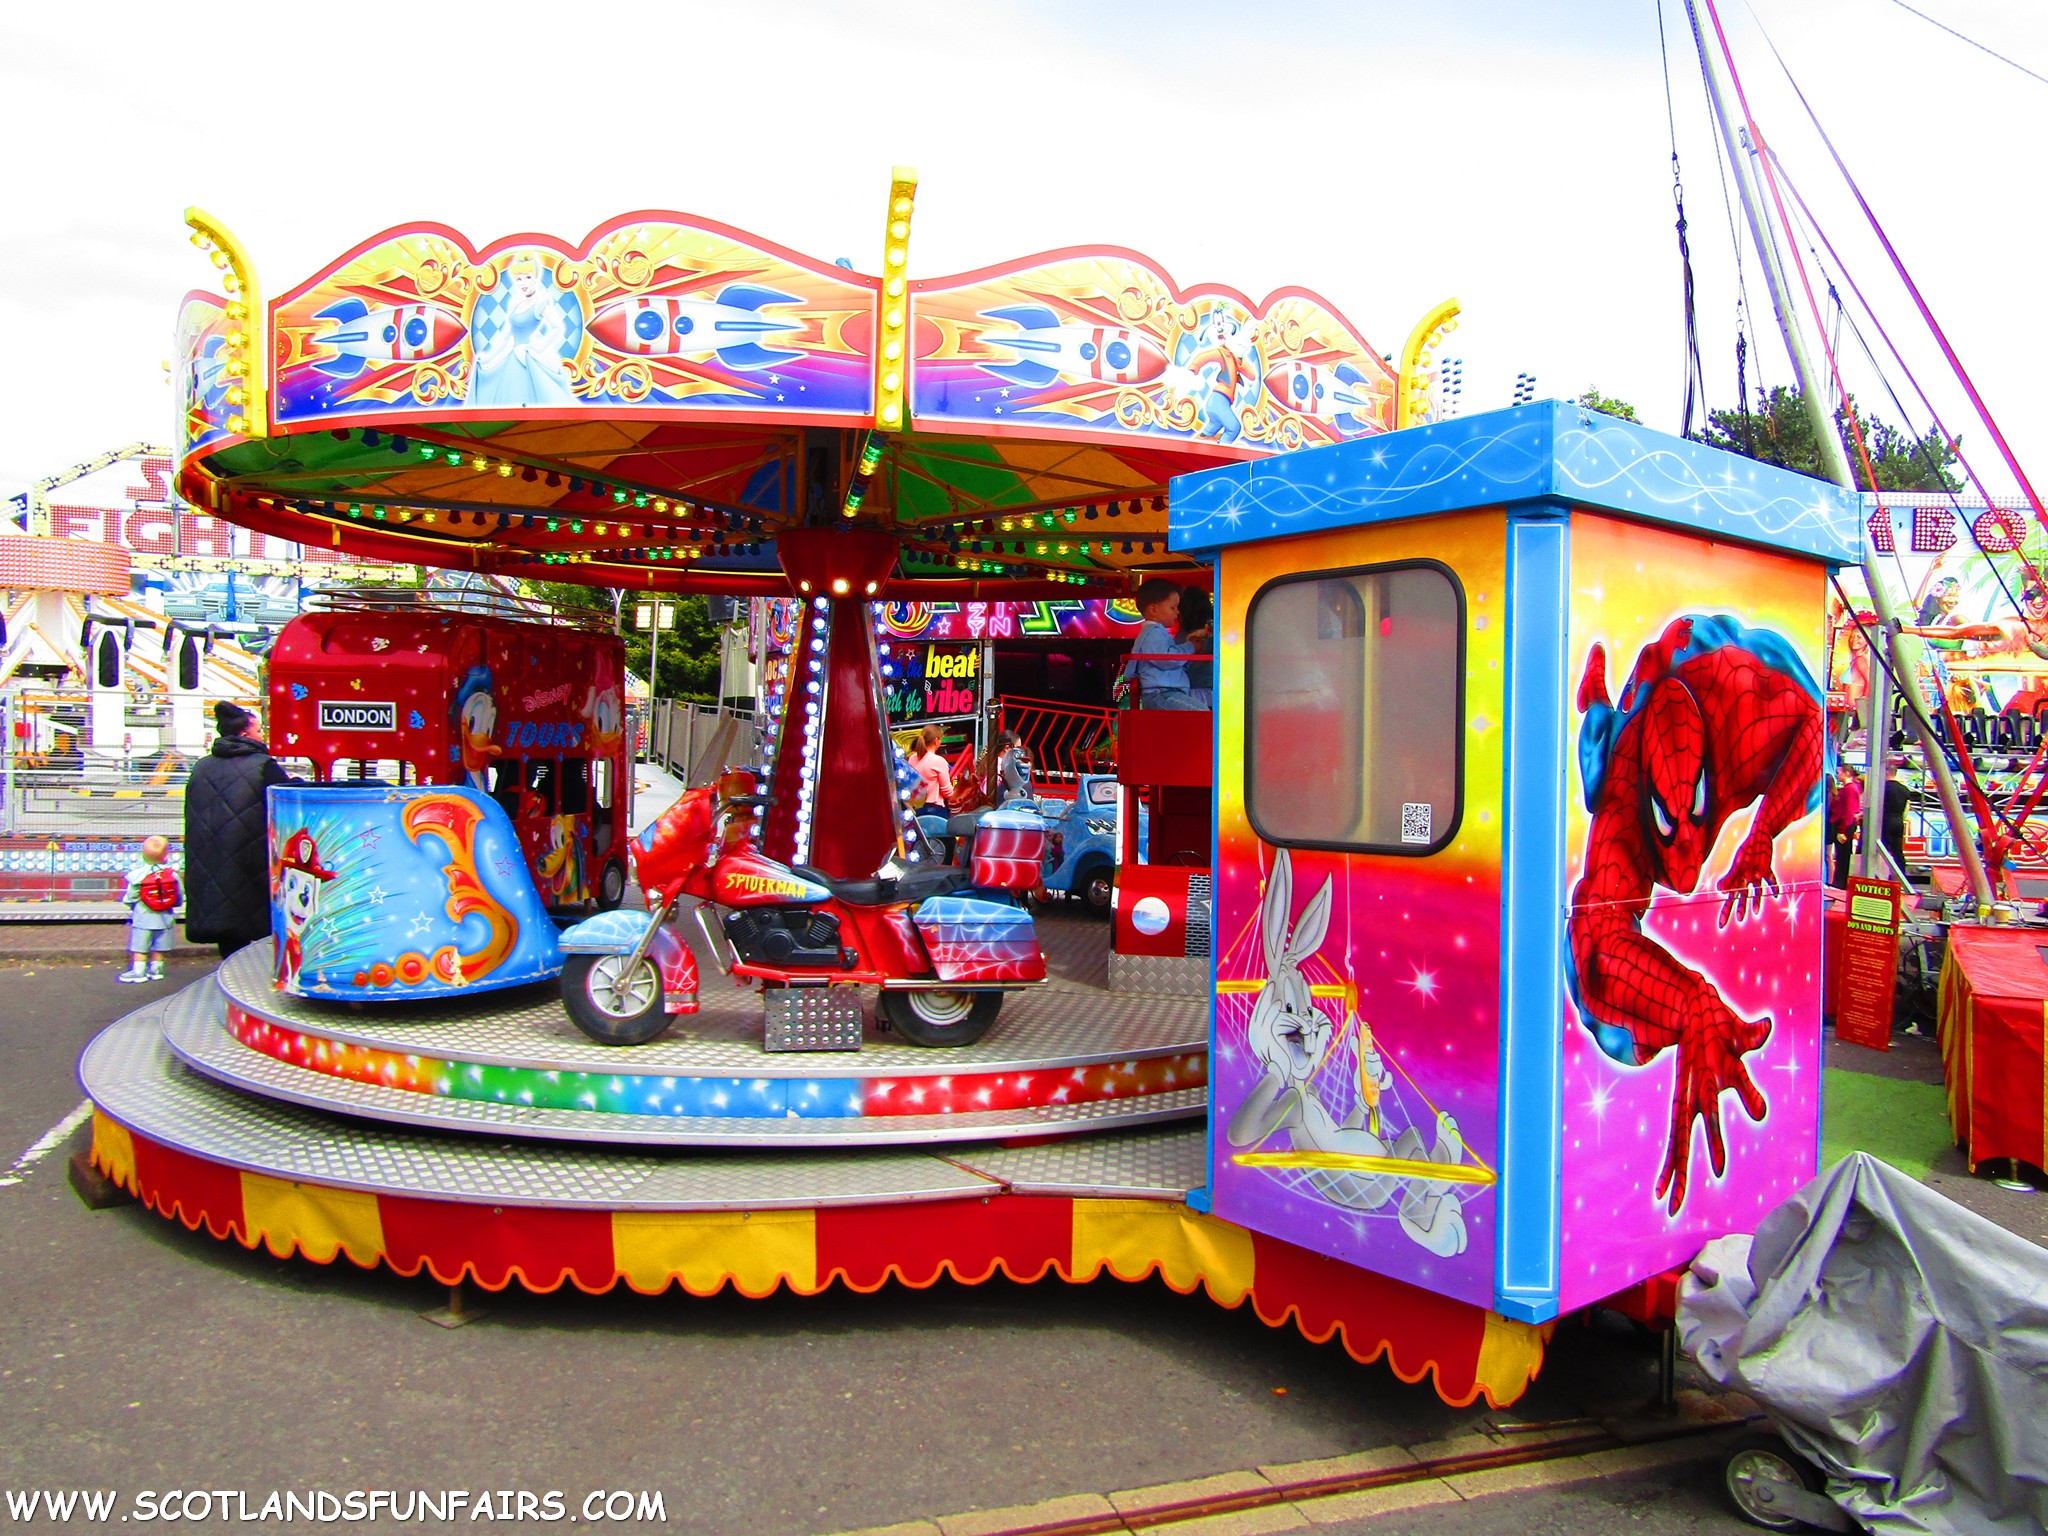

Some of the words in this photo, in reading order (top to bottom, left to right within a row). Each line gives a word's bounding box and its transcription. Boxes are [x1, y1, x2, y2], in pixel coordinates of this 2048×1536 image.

[925, 644, 977, 679] beat
[926, 678, 974, 713] vibe
[323, 708, 391, 724] LONDON
[507, 721, 585, 748] TOURS
[725, 873, 807, 899] SPIDERMAN
[1855, 884, 1891, 897] NOTICE
